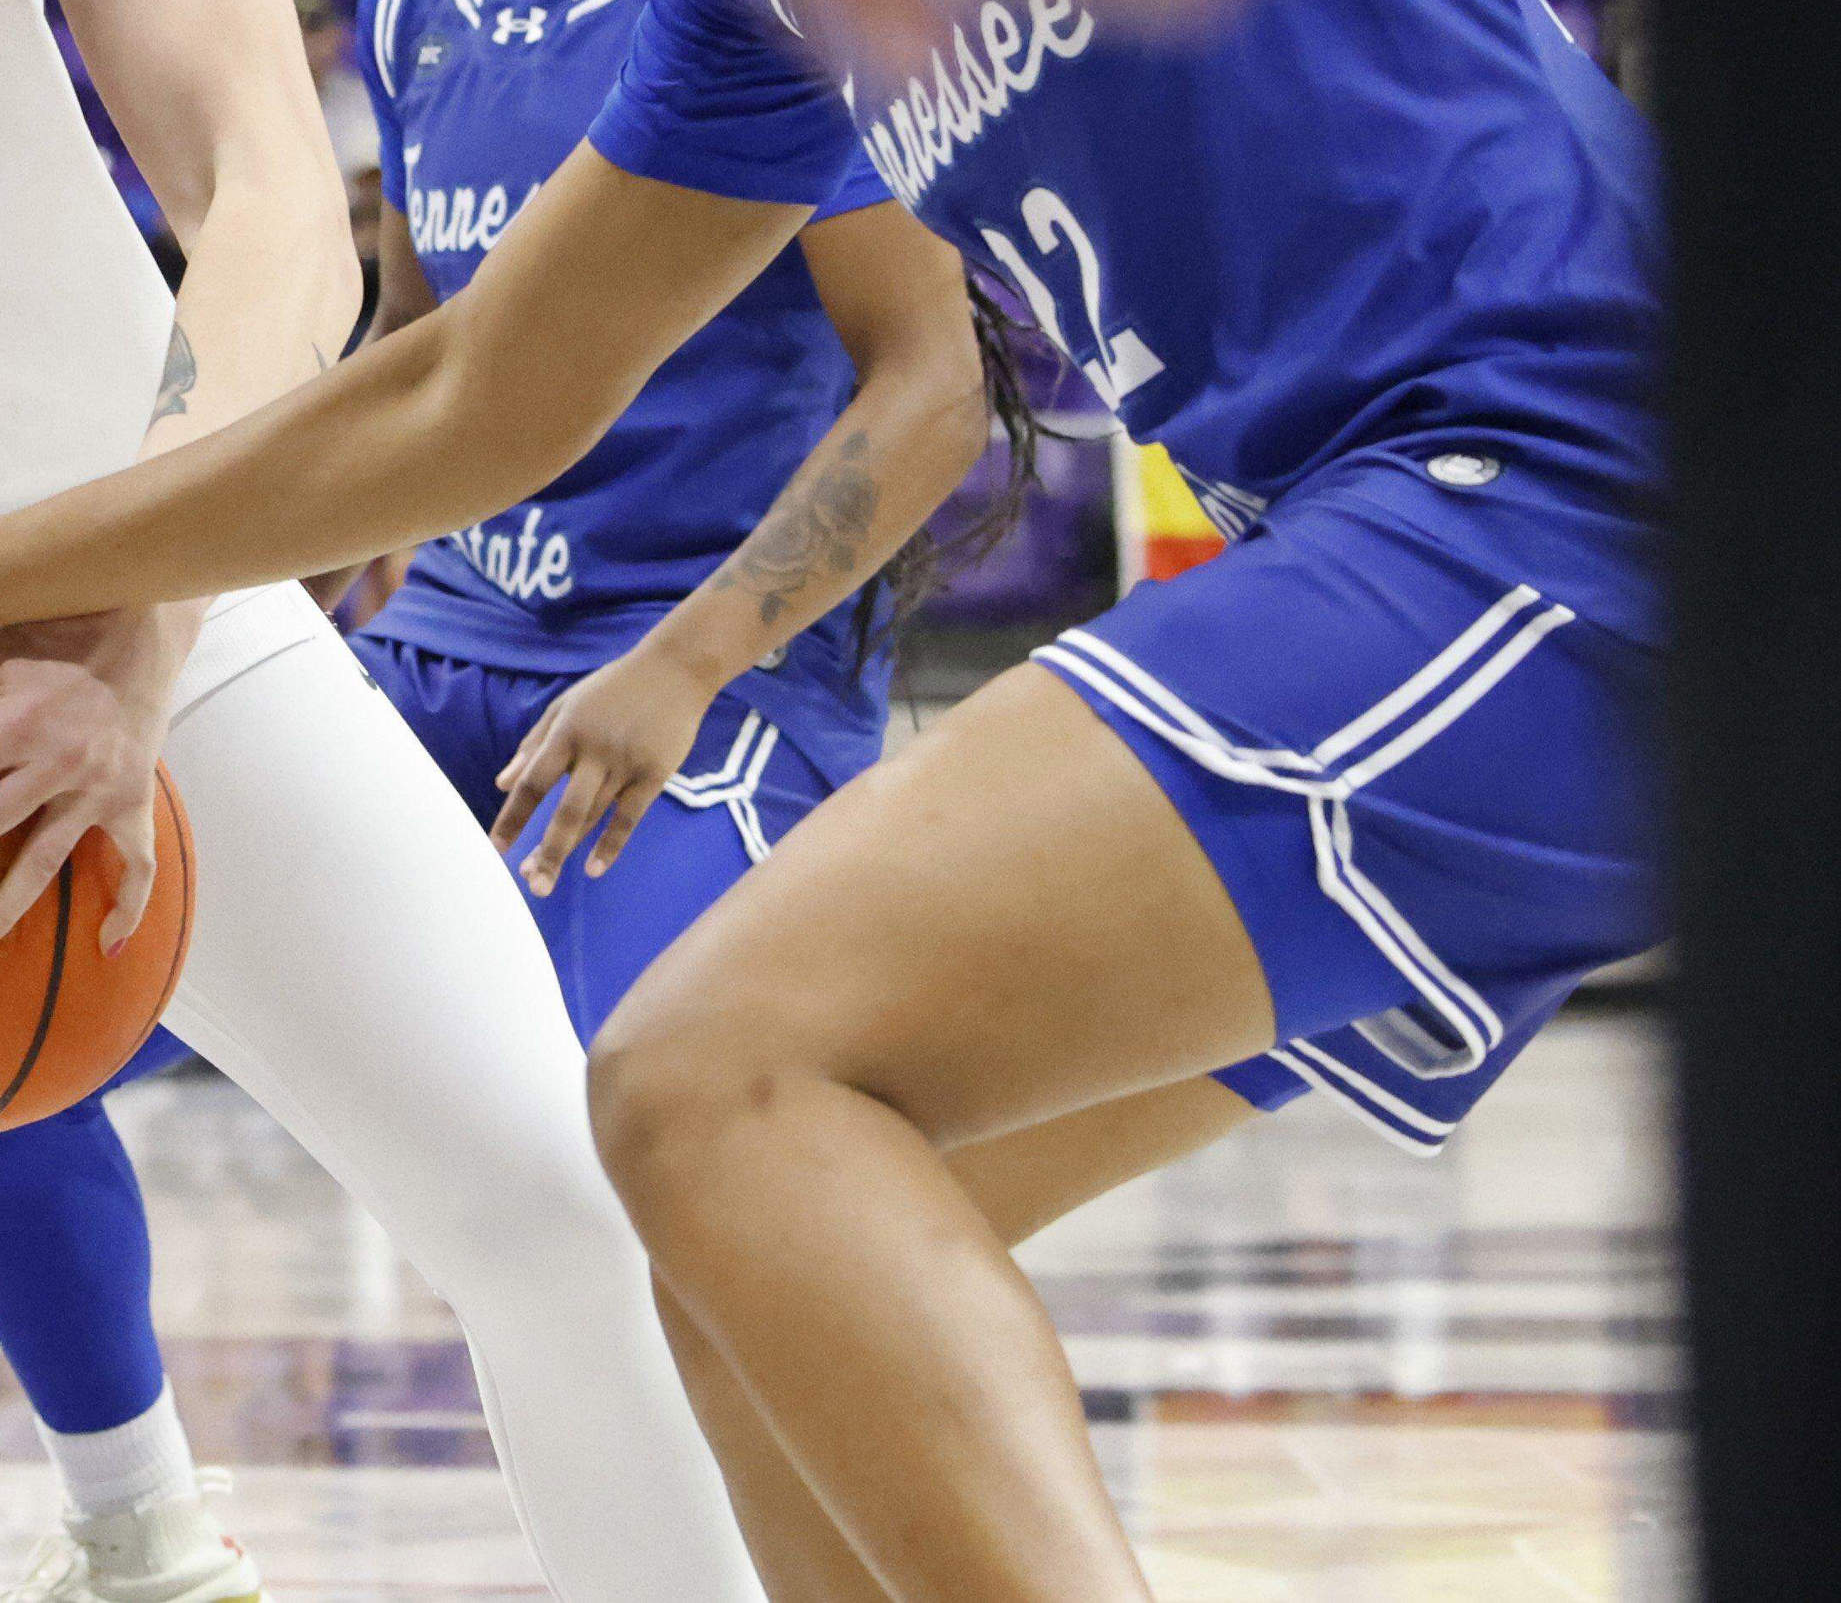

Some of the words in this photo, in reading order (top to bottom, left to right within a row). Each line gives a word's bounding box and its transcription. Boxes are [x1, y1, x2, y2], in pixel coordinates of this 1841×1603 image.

[403, 142, 542, 254] Tenne
[980, 187, 1166, 412] 12
[448, 507, 573, 601] tate
